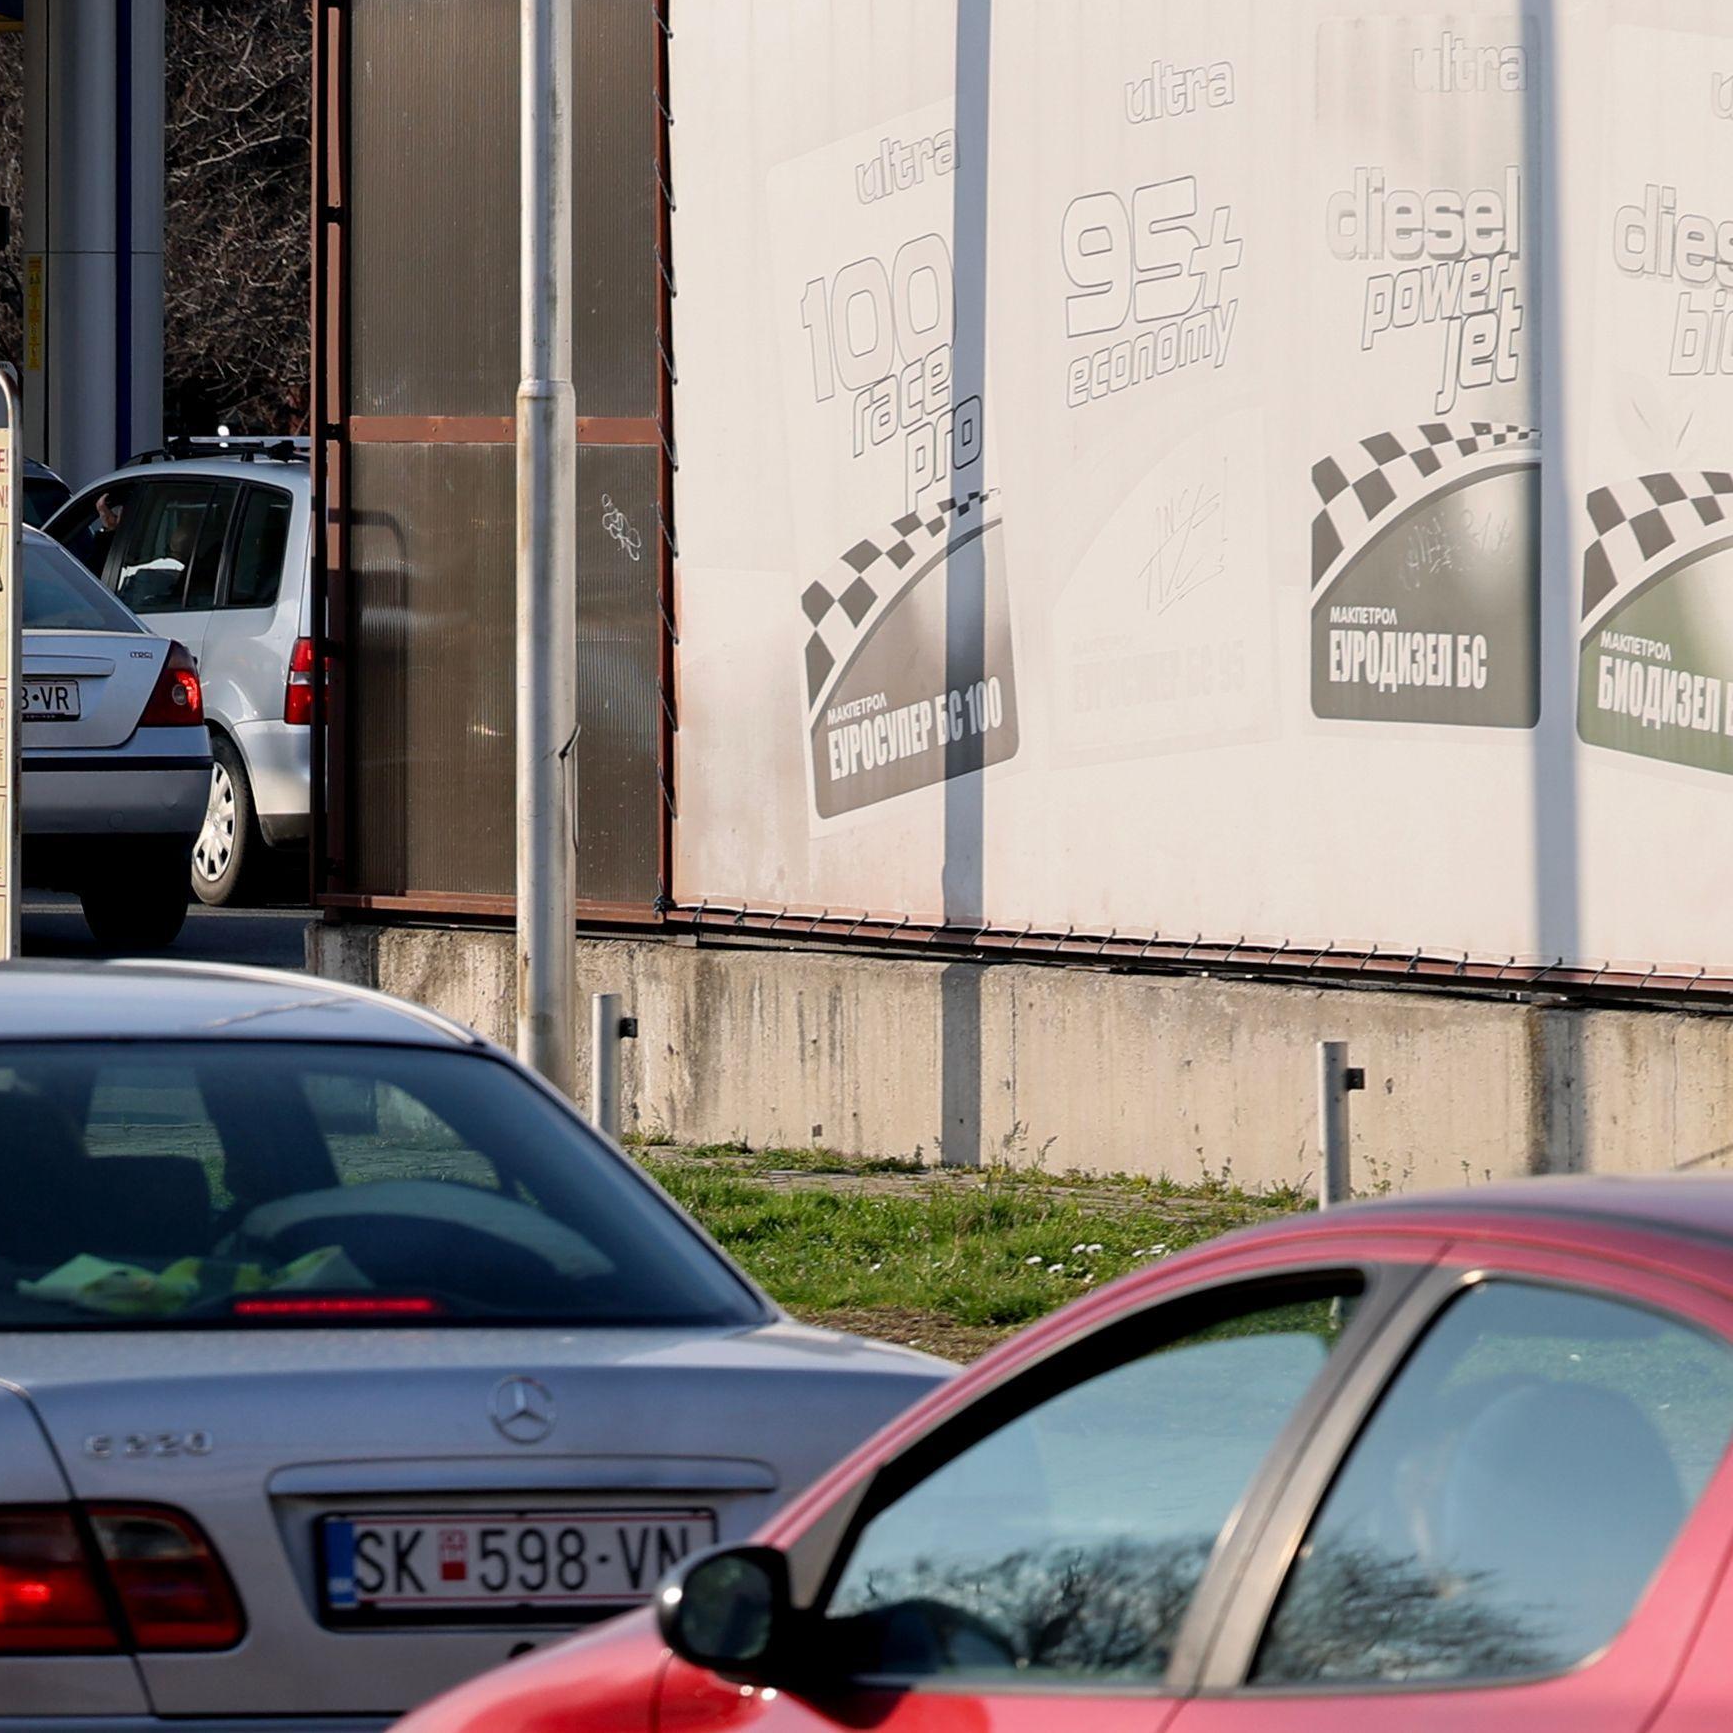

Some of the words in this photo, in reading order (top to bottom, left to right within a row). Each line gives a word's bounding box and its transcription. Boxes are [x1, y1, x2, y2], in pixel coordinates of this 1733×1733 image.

[1125, 59, 1235, 124] ultra
[855, 129, 961, 205] ultra
[1326, 165, 1521, 260] diesel
[1061, 174, 1244, 340] 95+
[1361, 251, 1511, 351] power
[801, 233, 956, 402] 100
[1067, 299, 1238, 409] economy
[1435, 287, 1524, 416] jet
[853, 344, 953, 458] race
[905, 395, 983, 516] pro
[1328, 628, 1453, 694] ЕУРОДИЗЕЛ
[1456, 634, 1488, 691] БС
[1330, 605, 1398, 626] МАКПЕТРОЛ
[1599, 630, 1672, 662] МАКПЕТРОЛ
[827, 691, 888, 726] МАКПЕТРОЛ
[828, 700, 933, 781] ЕУРОСУПЕР
[935, 689, 964, 746] БС
[965, 676, 1003, 735] 100
[1597, 654, 1721, 734] БИОДИЗЕЛ
[354, 1528, 427, 1595] SK
